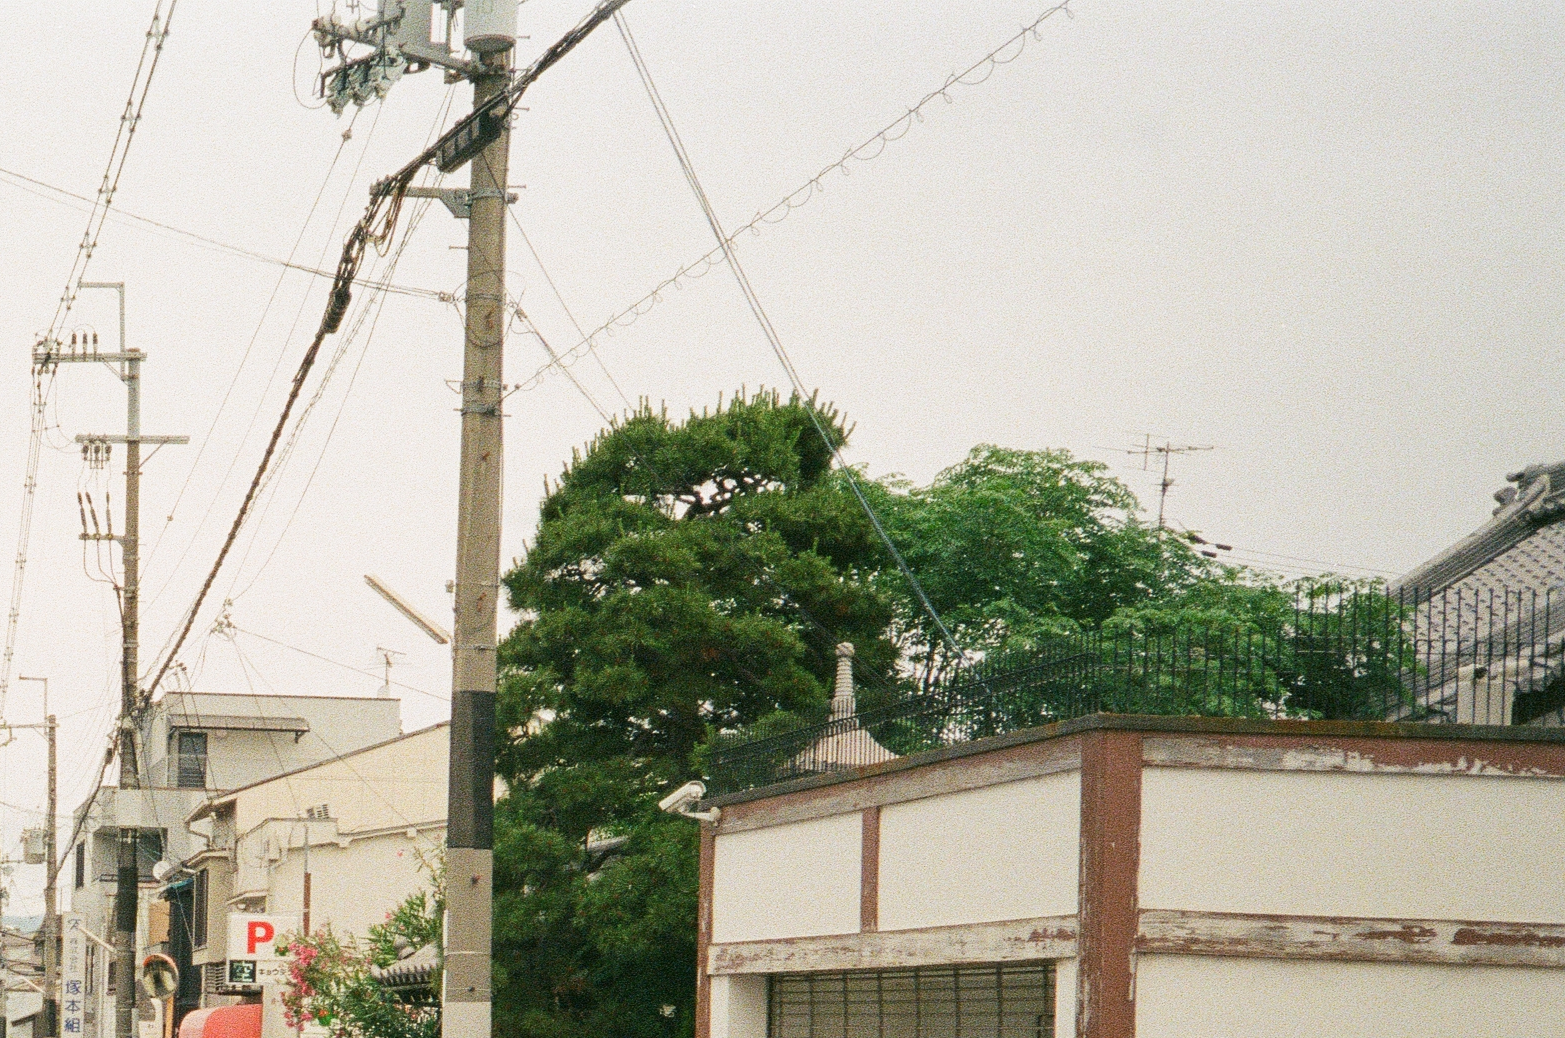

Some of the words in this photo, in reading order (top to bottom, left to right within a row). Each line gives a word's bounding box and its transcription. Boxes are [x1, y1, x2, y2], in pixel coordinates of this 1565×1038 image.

[247, 921, 274, 954] P
[64, 980, 82, 1033] 塚本組
